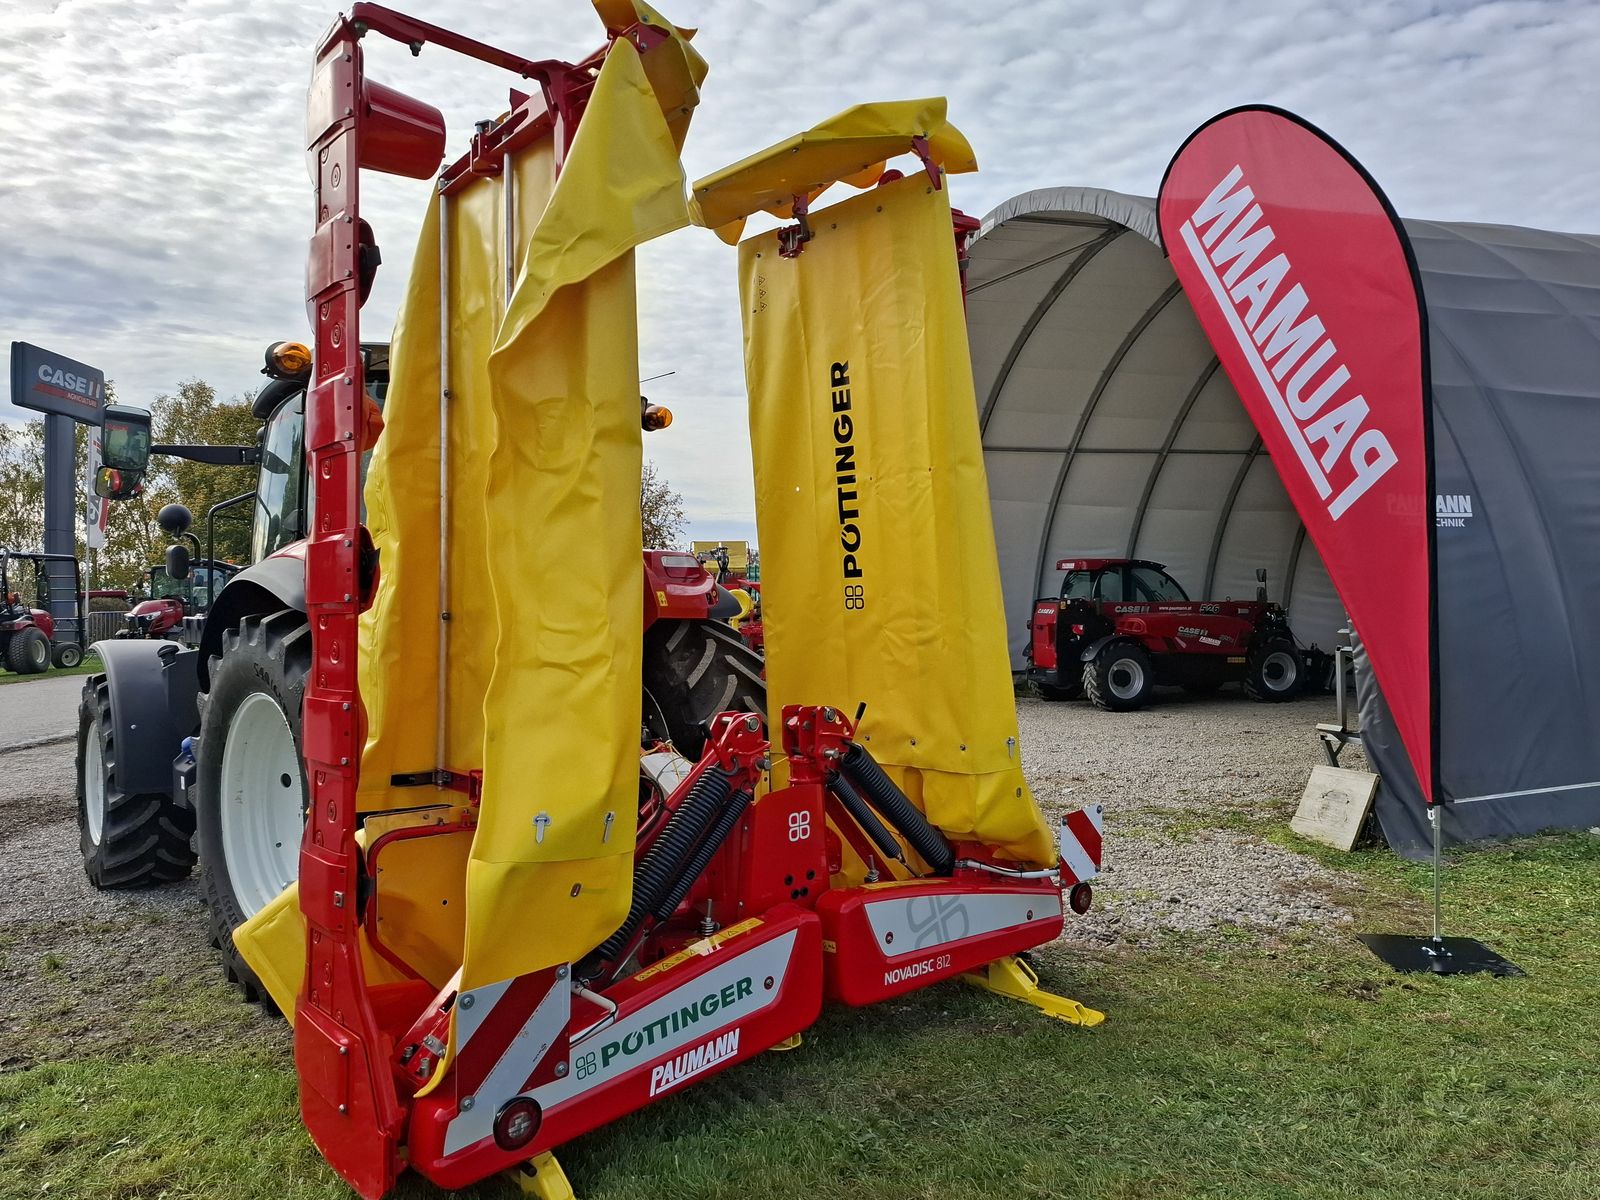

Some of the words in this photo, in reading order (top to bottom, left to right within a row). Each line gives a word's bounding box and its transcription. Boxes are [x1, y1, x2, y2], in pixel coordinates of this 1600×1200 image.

[38, 364, 87, 393] CASE
[830, 360, 863, 578] PÖTTINGER
[1200, 604, 1220, 614] 526
[1178, 626, 1200, 636] CASE
[884, 958, 935, 986] NOVADISC
[936, 954, 951, 970] 812
[601, 976, 753, 1068] PÖTTINGER
[650, 1028, 741, 1098] PAUMANN
